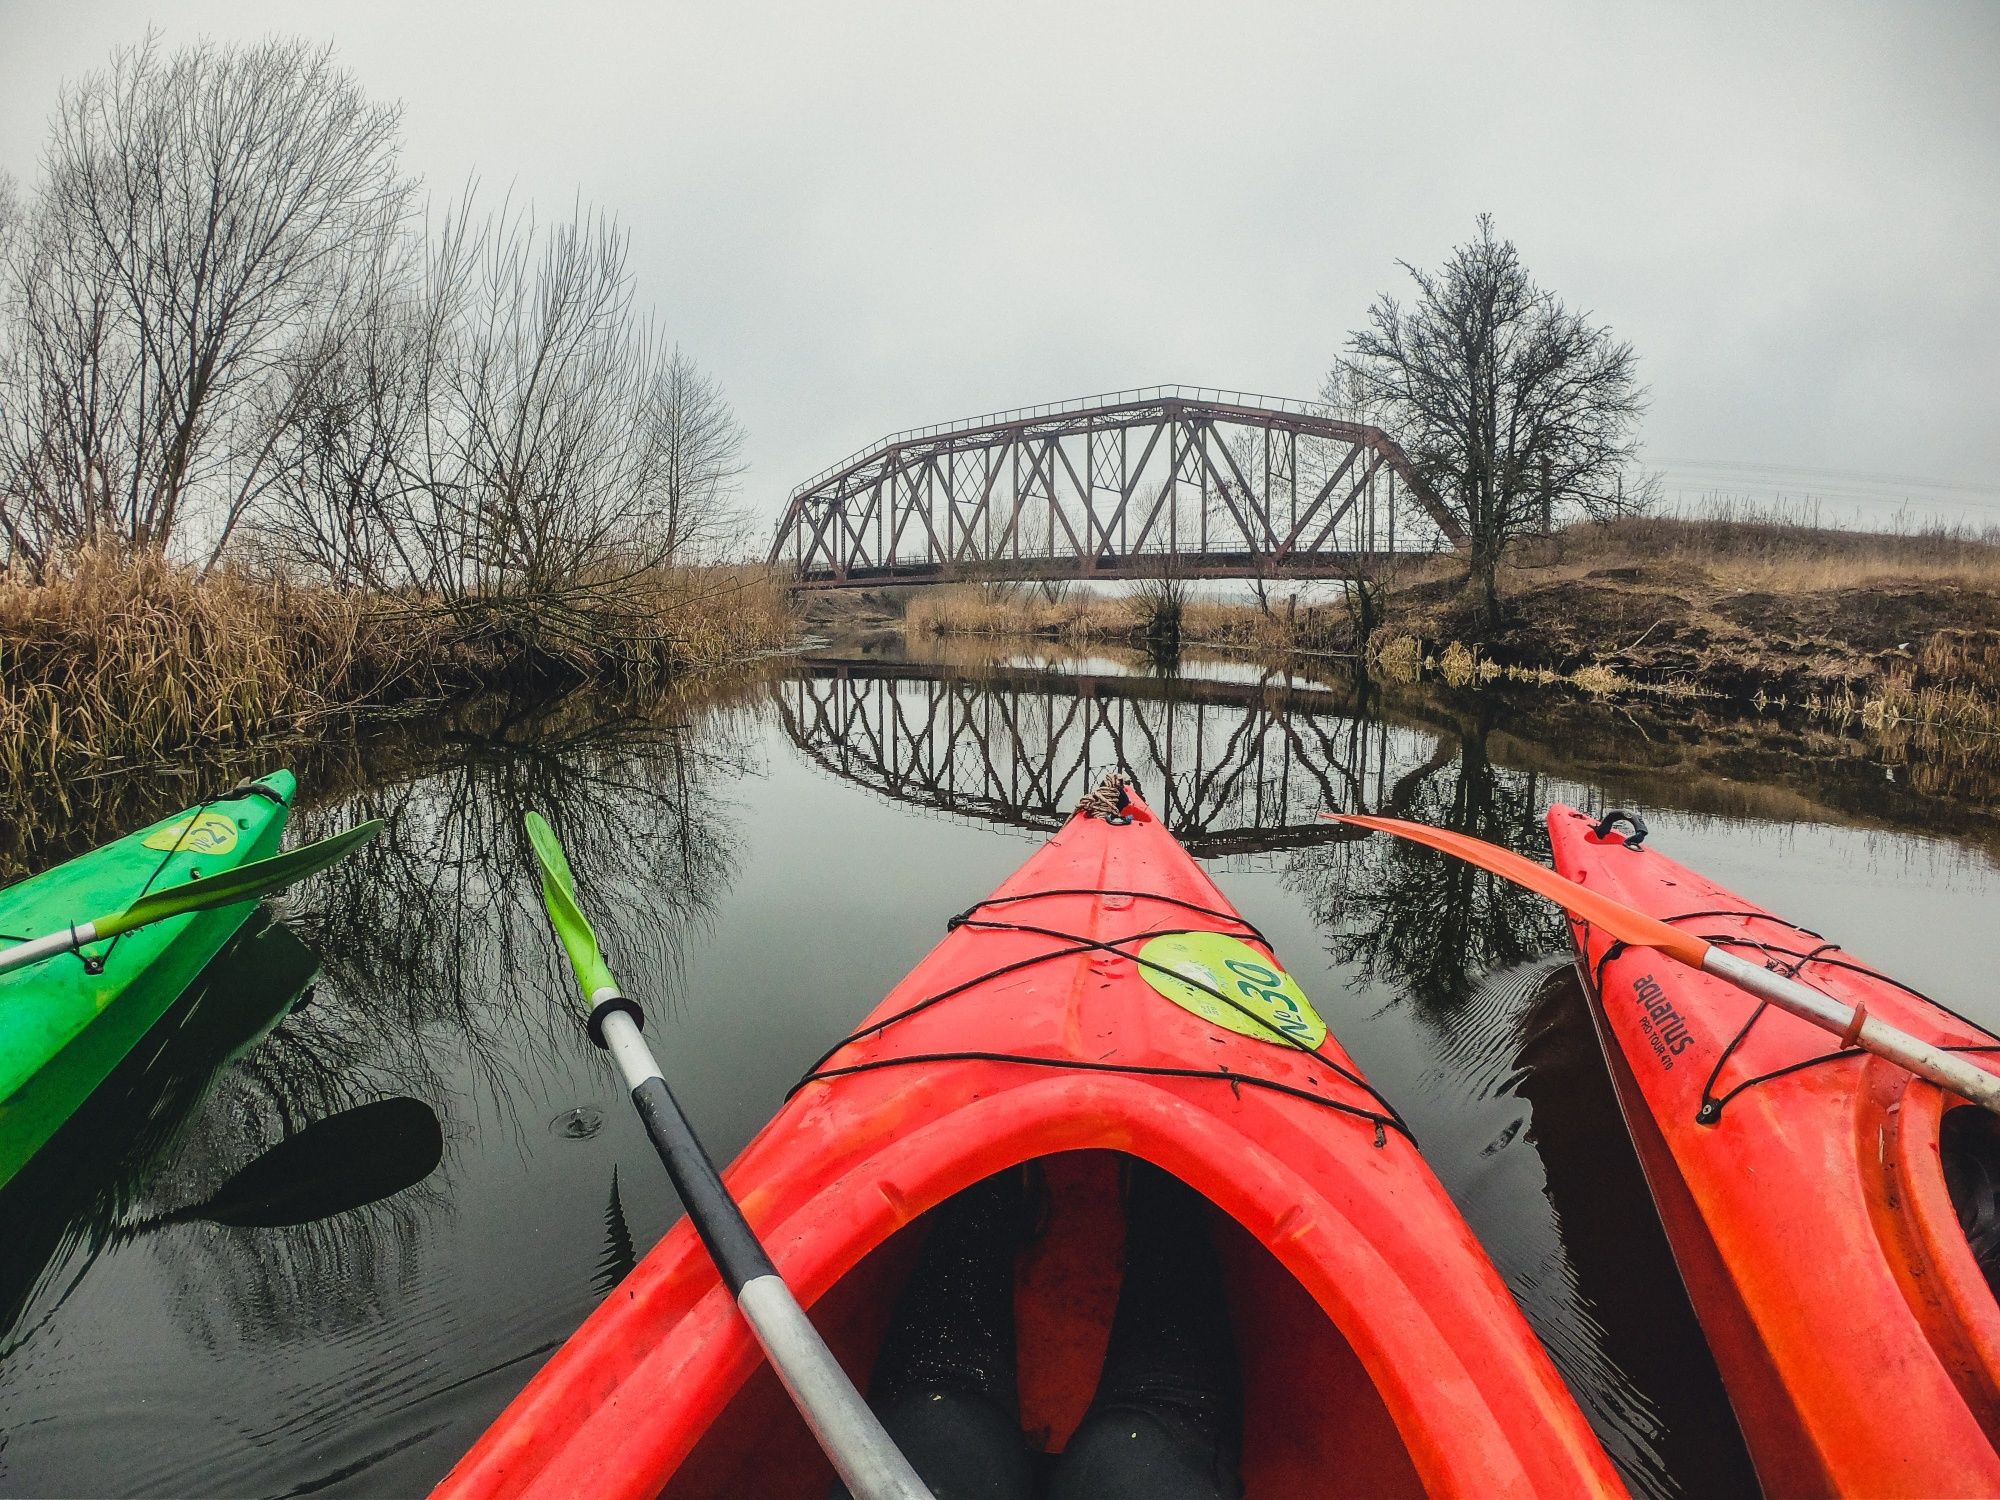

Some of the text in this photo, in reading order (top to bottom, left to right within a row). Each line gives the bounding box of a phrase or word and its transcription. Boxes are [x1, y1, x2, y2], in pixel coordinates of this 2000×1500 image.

[1633, 974, 1695, 1056] aquarius
[1639, 1016, 1653, 1034] PRO
[1648, 1031, 1666, 1057] TOUR
